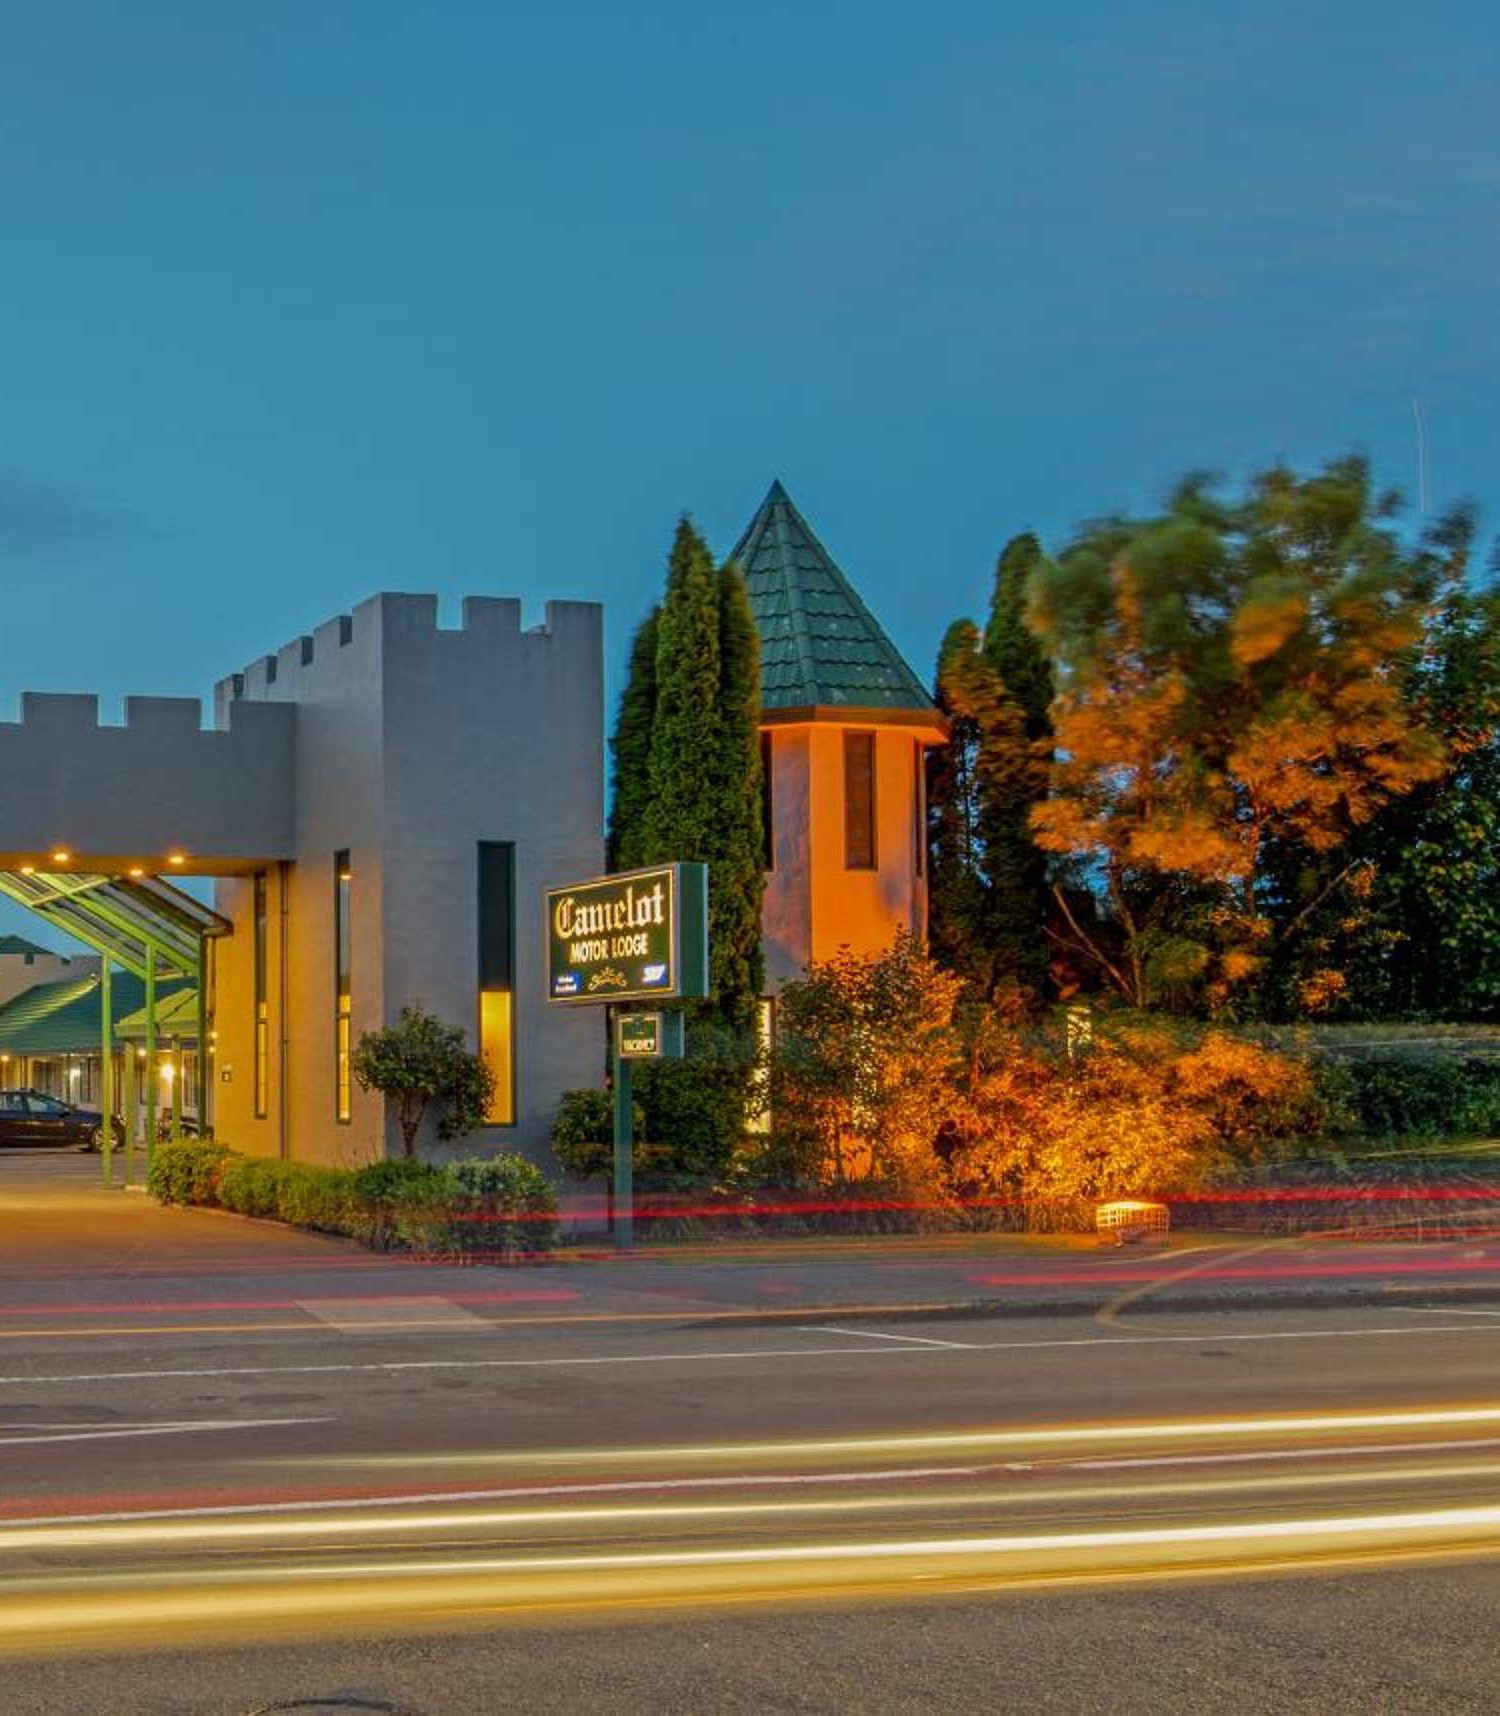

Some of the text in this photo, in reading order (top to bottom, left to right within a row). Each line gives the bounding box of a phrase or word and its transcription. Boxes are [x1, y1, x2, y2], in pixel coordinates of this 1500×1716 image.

[555, 884, 664, 939] Camelot
[570, 933, 648, 963] MOTOR LODGE
